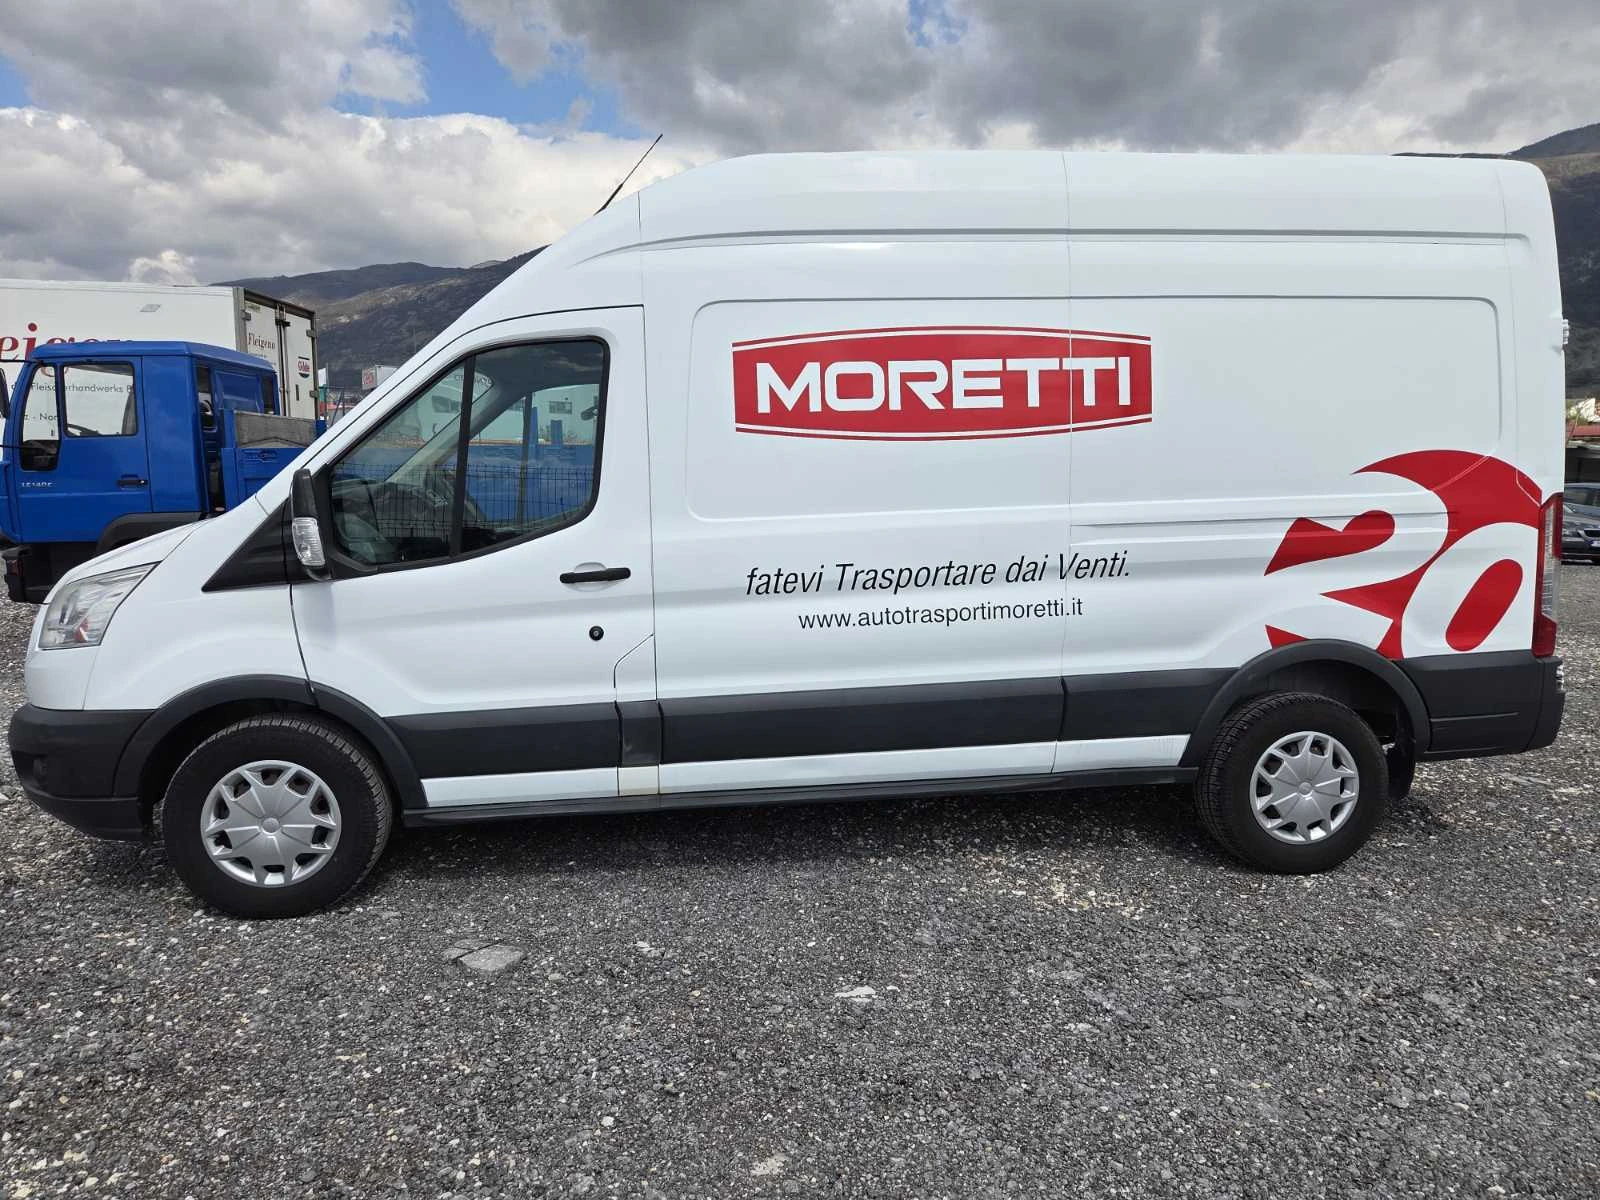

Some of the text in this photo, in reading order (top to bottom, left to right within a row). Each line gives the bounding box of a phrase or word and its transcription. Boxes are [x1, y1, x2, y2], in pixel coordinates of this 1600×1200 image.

[756, 356, 1131, 414] MORETTI
[746, 550, 1131, 595] fatevi Trasportare dai Venti.
[798, 598, 1083, 630] www.autotrasportimoretti.it
